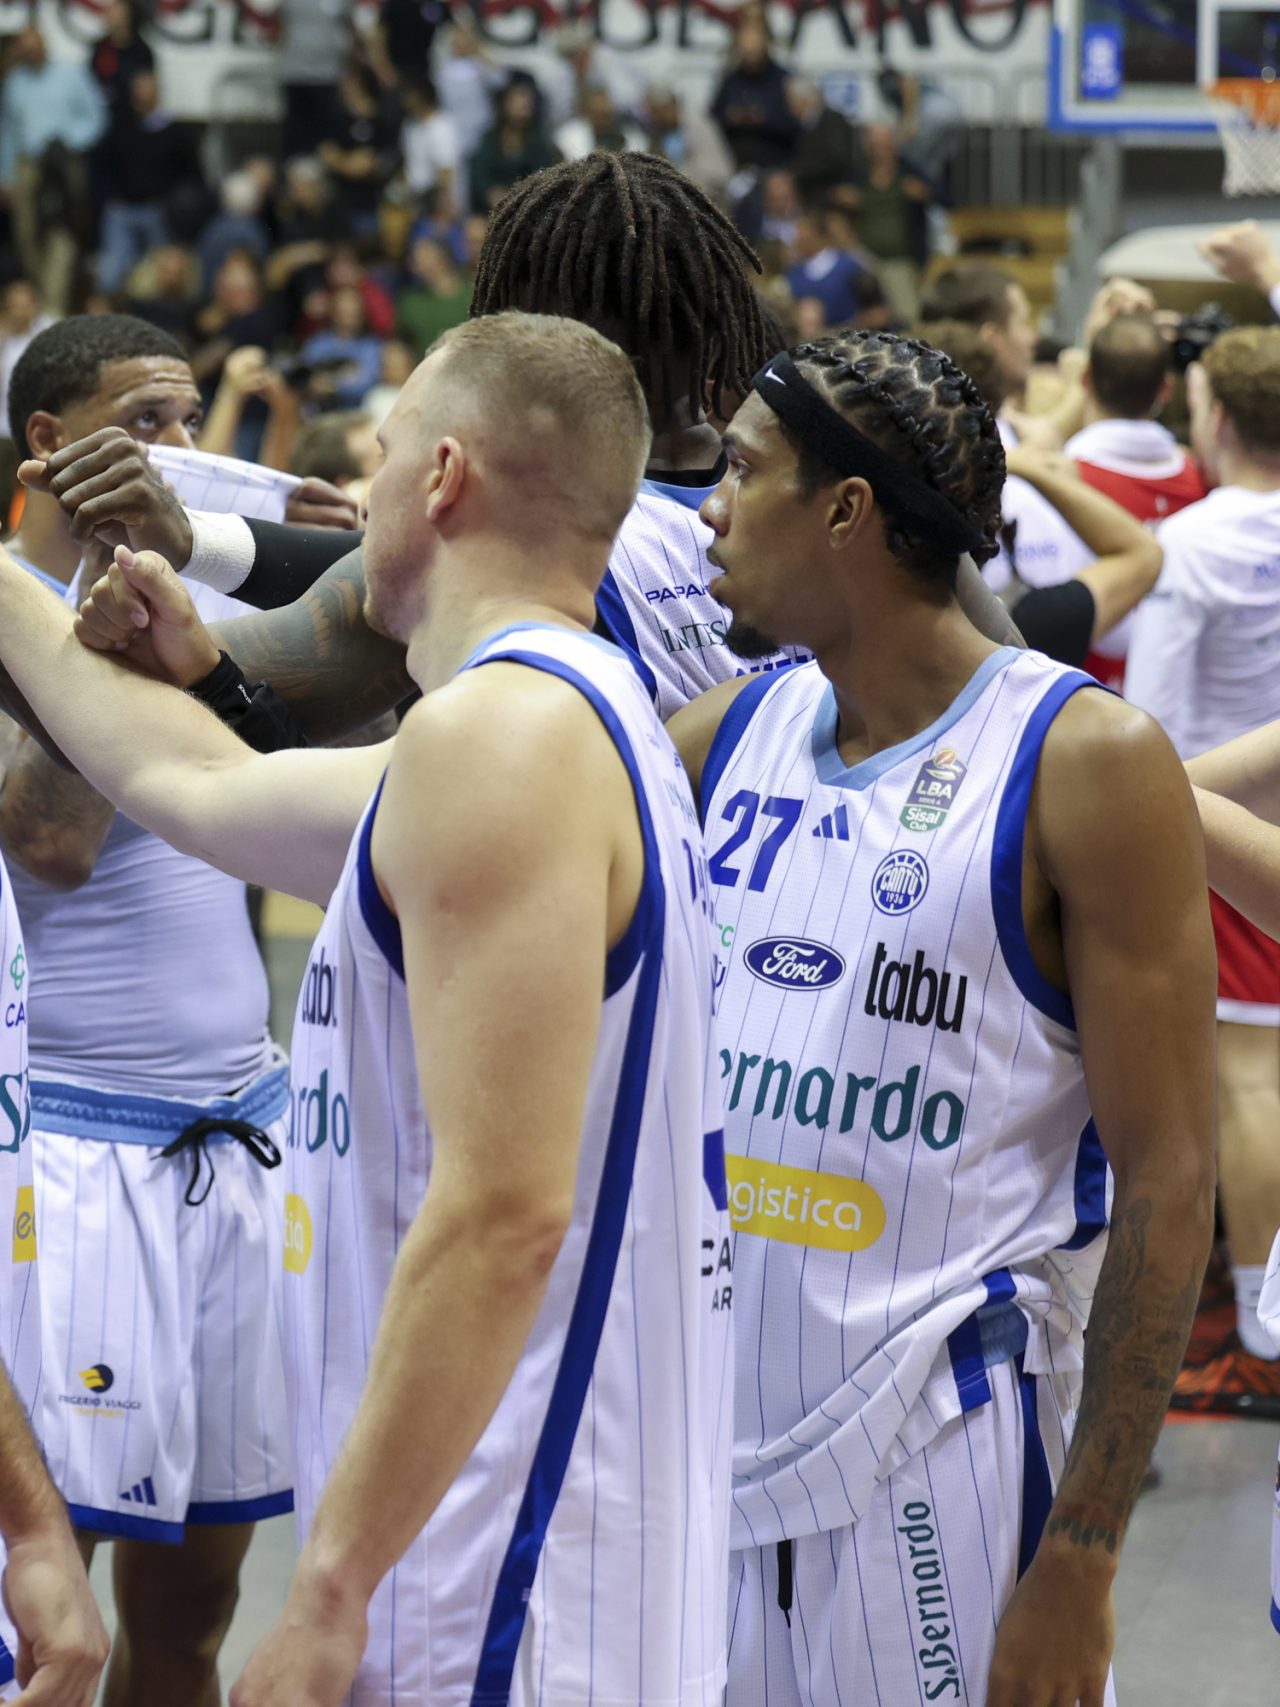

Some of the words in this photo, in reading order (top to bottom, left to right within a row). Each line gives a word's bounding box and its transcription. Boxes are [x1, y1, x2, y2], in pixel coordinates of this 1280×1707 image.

[662, 620, 728, 653] INTES
[915, 779, 952, 800] LBA
[906, 807, 941, 824] Sisal
[909, 820, 928, 831] Club
[708, 788, 804, 892] 27
[885, 892, 904, 904] 1936
[762, 943, 828, 983] Ford
[864, 941, 968, 1034] tabu
